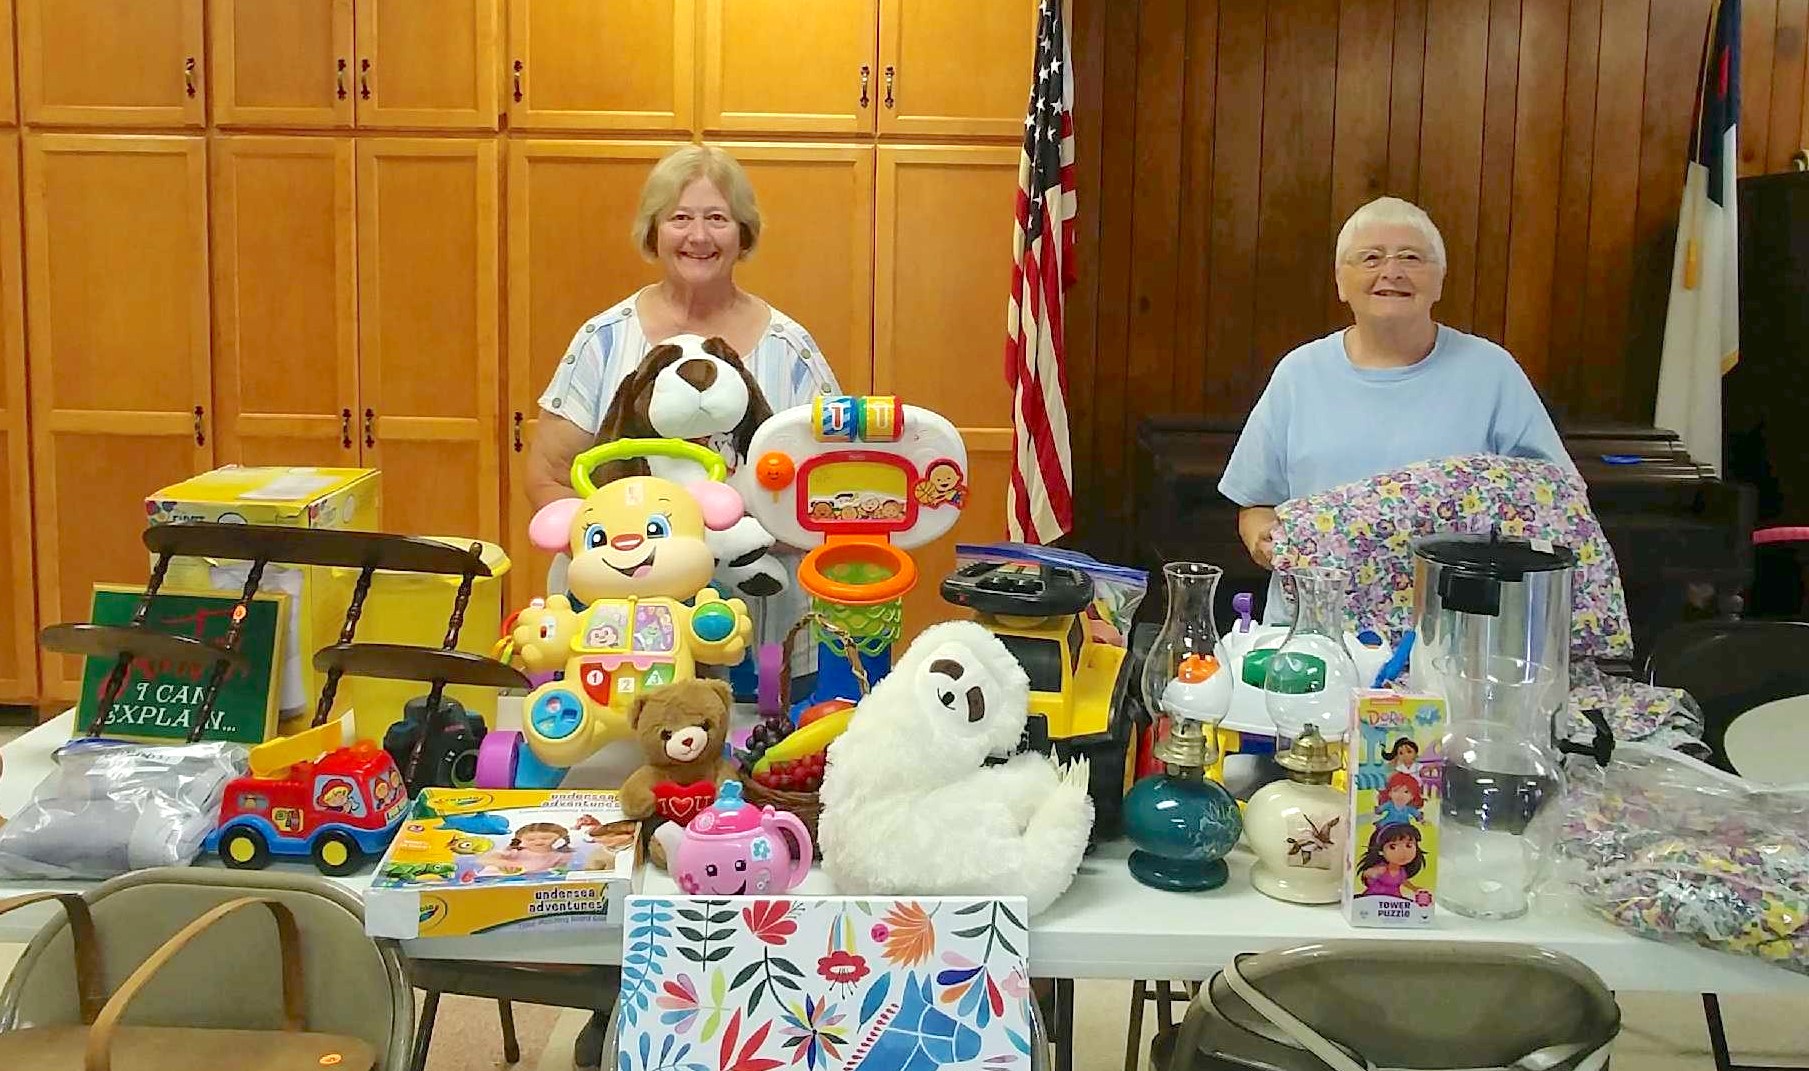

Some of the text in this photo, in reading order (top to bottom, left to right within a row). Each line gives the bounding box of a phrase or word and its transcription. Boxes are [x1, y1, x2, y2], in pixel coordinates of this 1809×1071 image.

[136, 682, 205, 705] I CAN
[104, 704, 236, 731] XPLAN...
[657, 797, 668, 815] I
[535, 887, 595, 900] undersea
[529, 901, 603, 913] adventures
[1378, 901, 1411, 909] TOWER
